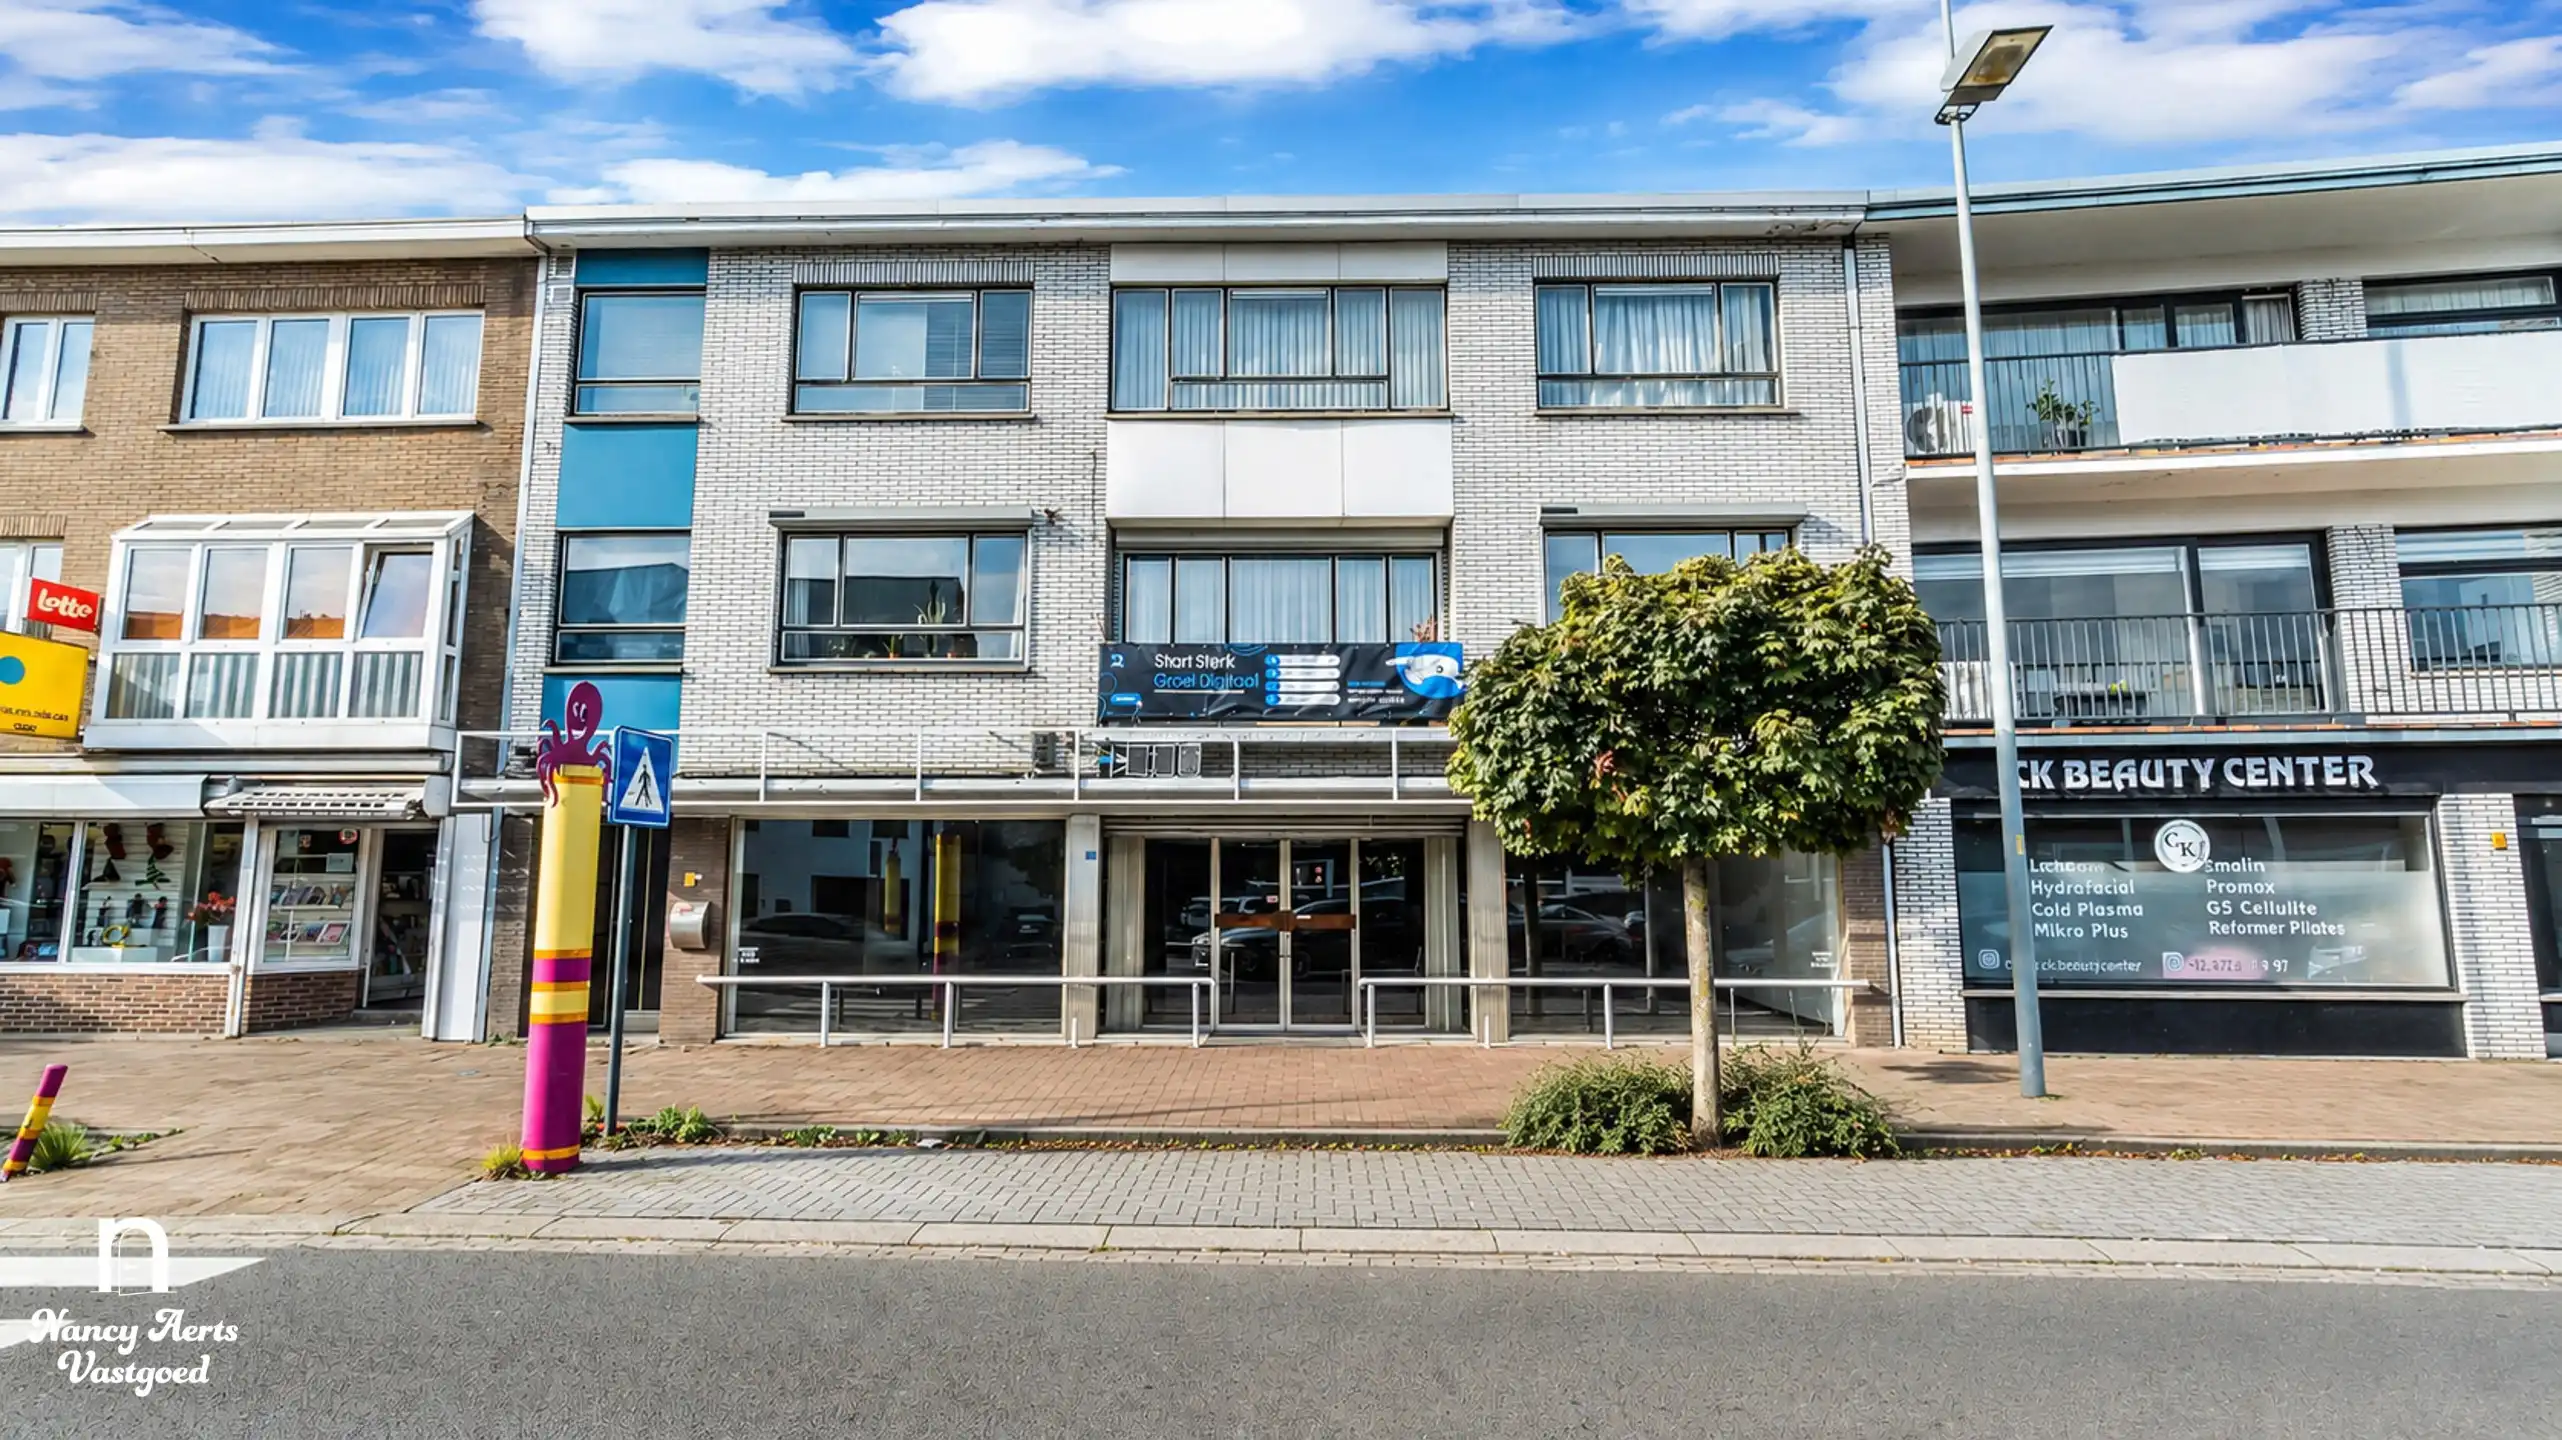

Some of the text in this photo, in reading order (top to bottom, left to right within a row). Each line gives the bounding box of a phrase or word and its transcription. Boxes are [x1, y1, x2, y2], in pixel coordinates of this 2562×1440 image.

[37, 588, 93, 618] Lotte
[2063, 758, 2216, 792] BEAUTY
[2223, 754, 2379, 789] CENTER
[2206, 878, 2275, 895] Promox
[2031, 902, 2144, 918] Cold Plasma
[2240, 899, 2318, 916] Cellulite
[2034, 922, 2129, 938] Mikro Plus
[2208, 919, 2346, 937] Reformer Pilates
